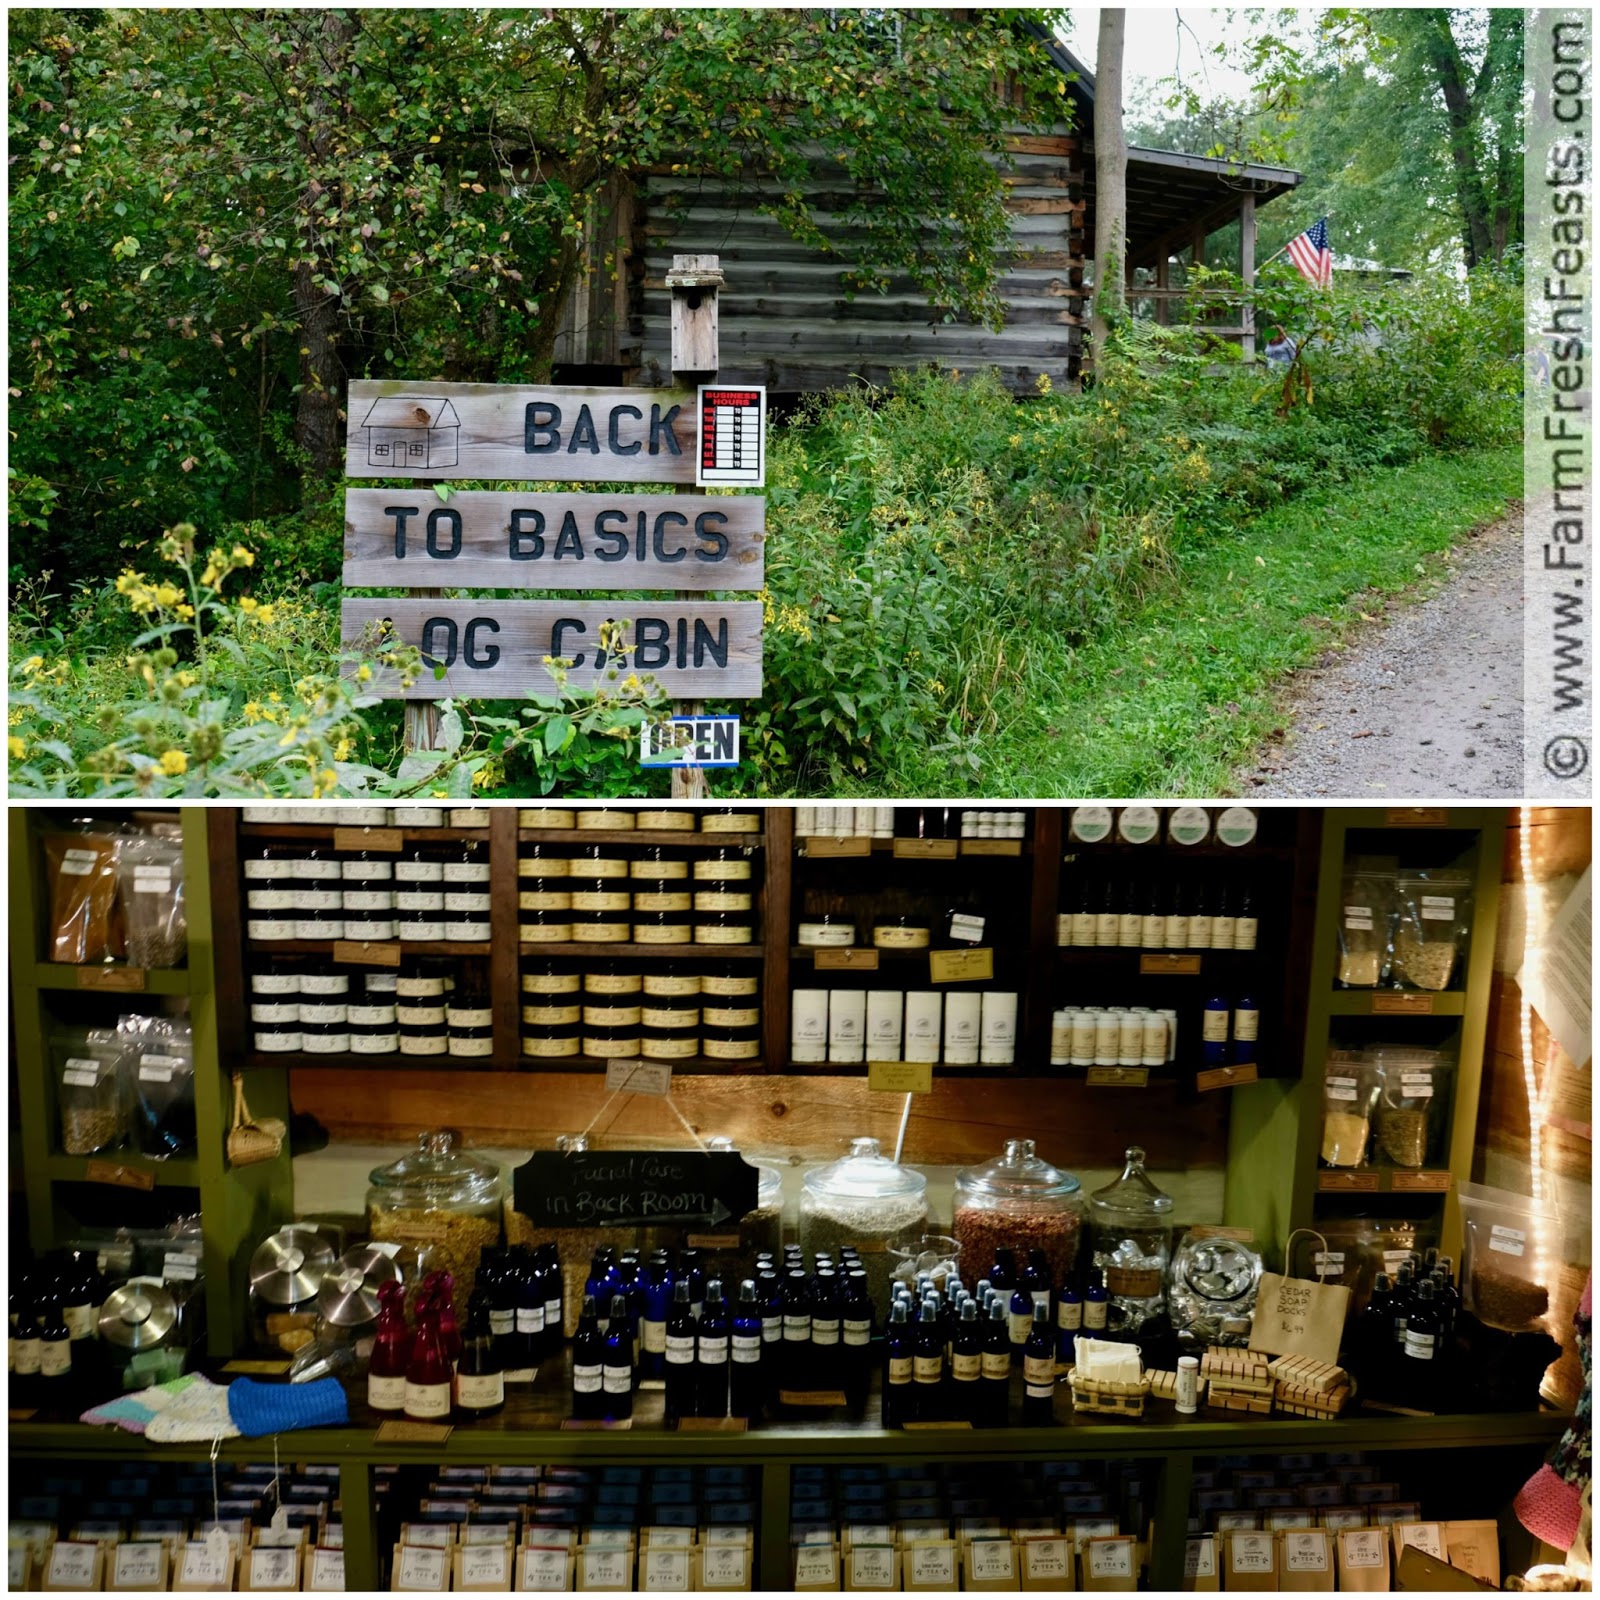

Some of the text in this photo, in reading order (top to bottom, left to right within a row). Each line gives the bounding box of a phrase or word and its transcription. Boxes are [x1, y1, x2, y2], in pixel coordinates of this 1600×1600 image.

[705, 392, 758, 400] BUSINESS
[525, 401, 682, 456] BACK
[384, 506, 729, 563] TO BASICS
[551, 616, 729, 670] CABIN
[572, 1158, 634, 1186] Facial
[576, 1190, 634, 1222] Back
[641, 1192, 706, 1215] Room
[1280, 1285, 1312, 1298] CEDAR
[1280, 1295, 1308, 1306] SOAP
[1277, 1305, 1307, 1316] DOCKS
